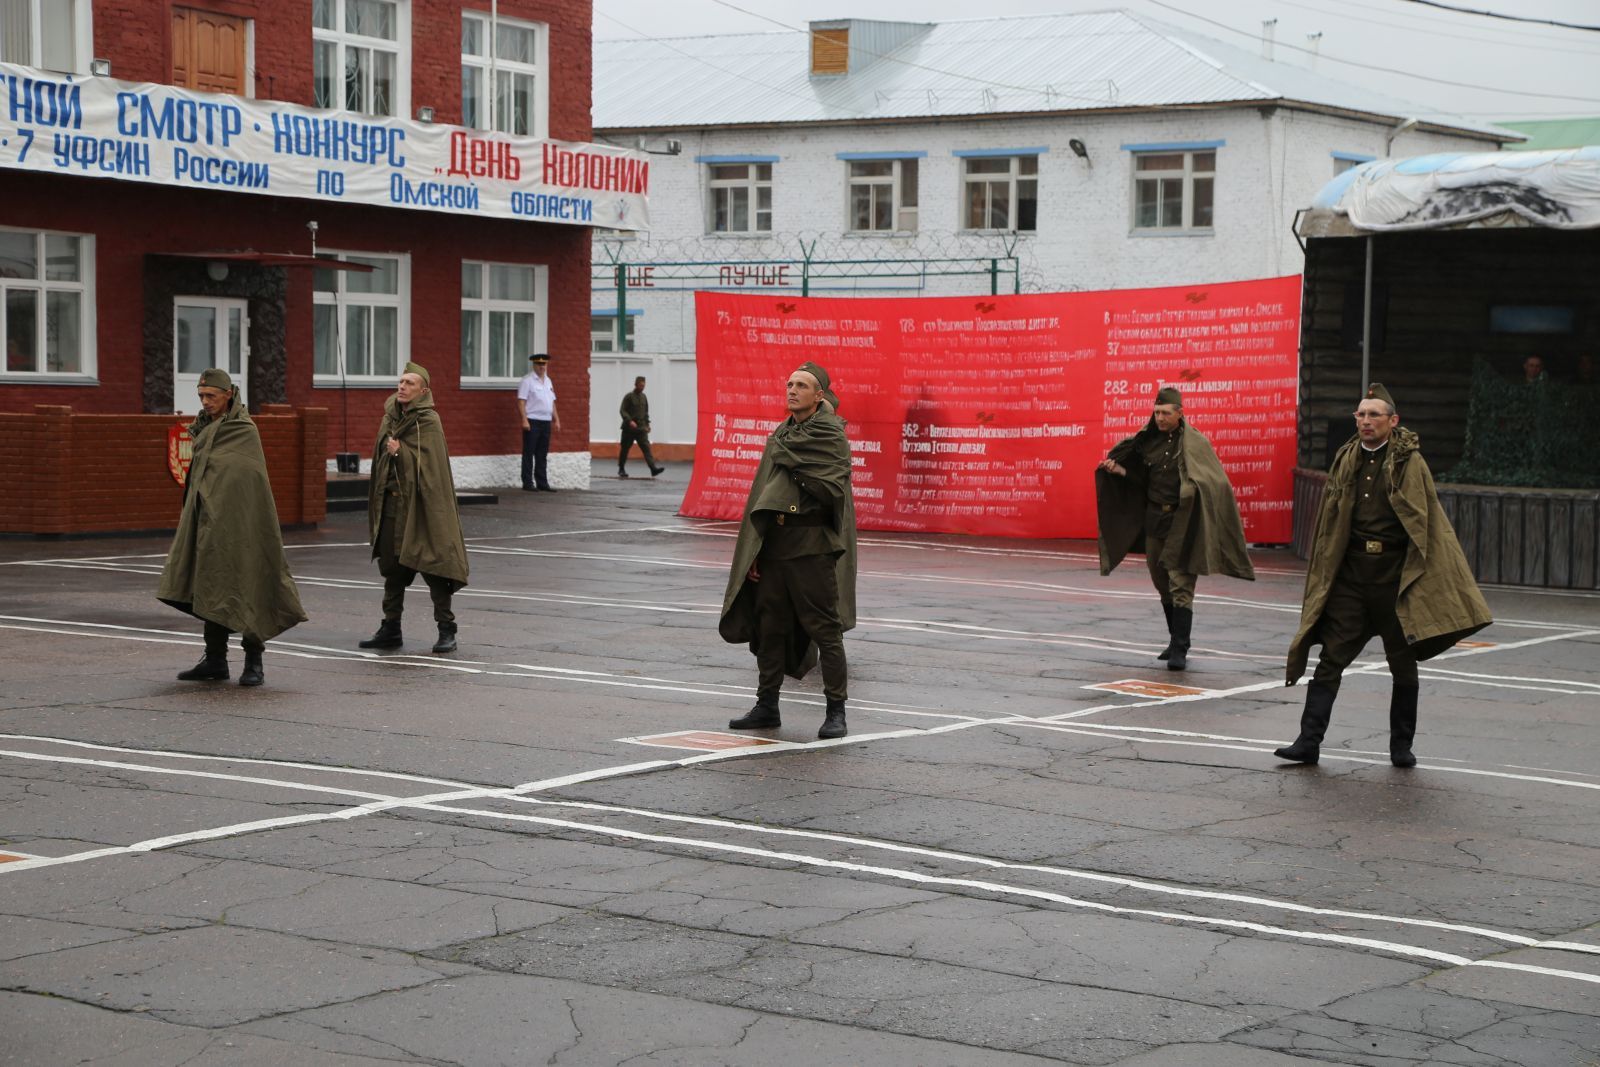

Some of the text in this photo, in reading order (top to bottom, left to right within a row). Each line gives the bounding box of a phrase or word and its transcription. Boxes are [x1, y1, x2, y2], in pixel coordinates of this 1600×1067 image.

[0, 74, 82, 129] НОЙ
[117, 92, 242, 147] СМОТР
[271, 112, 405, 168] КОНКУРС
[54, 133, 150, 176] УФСИН
[1107, 341, 1120, 356] 37
